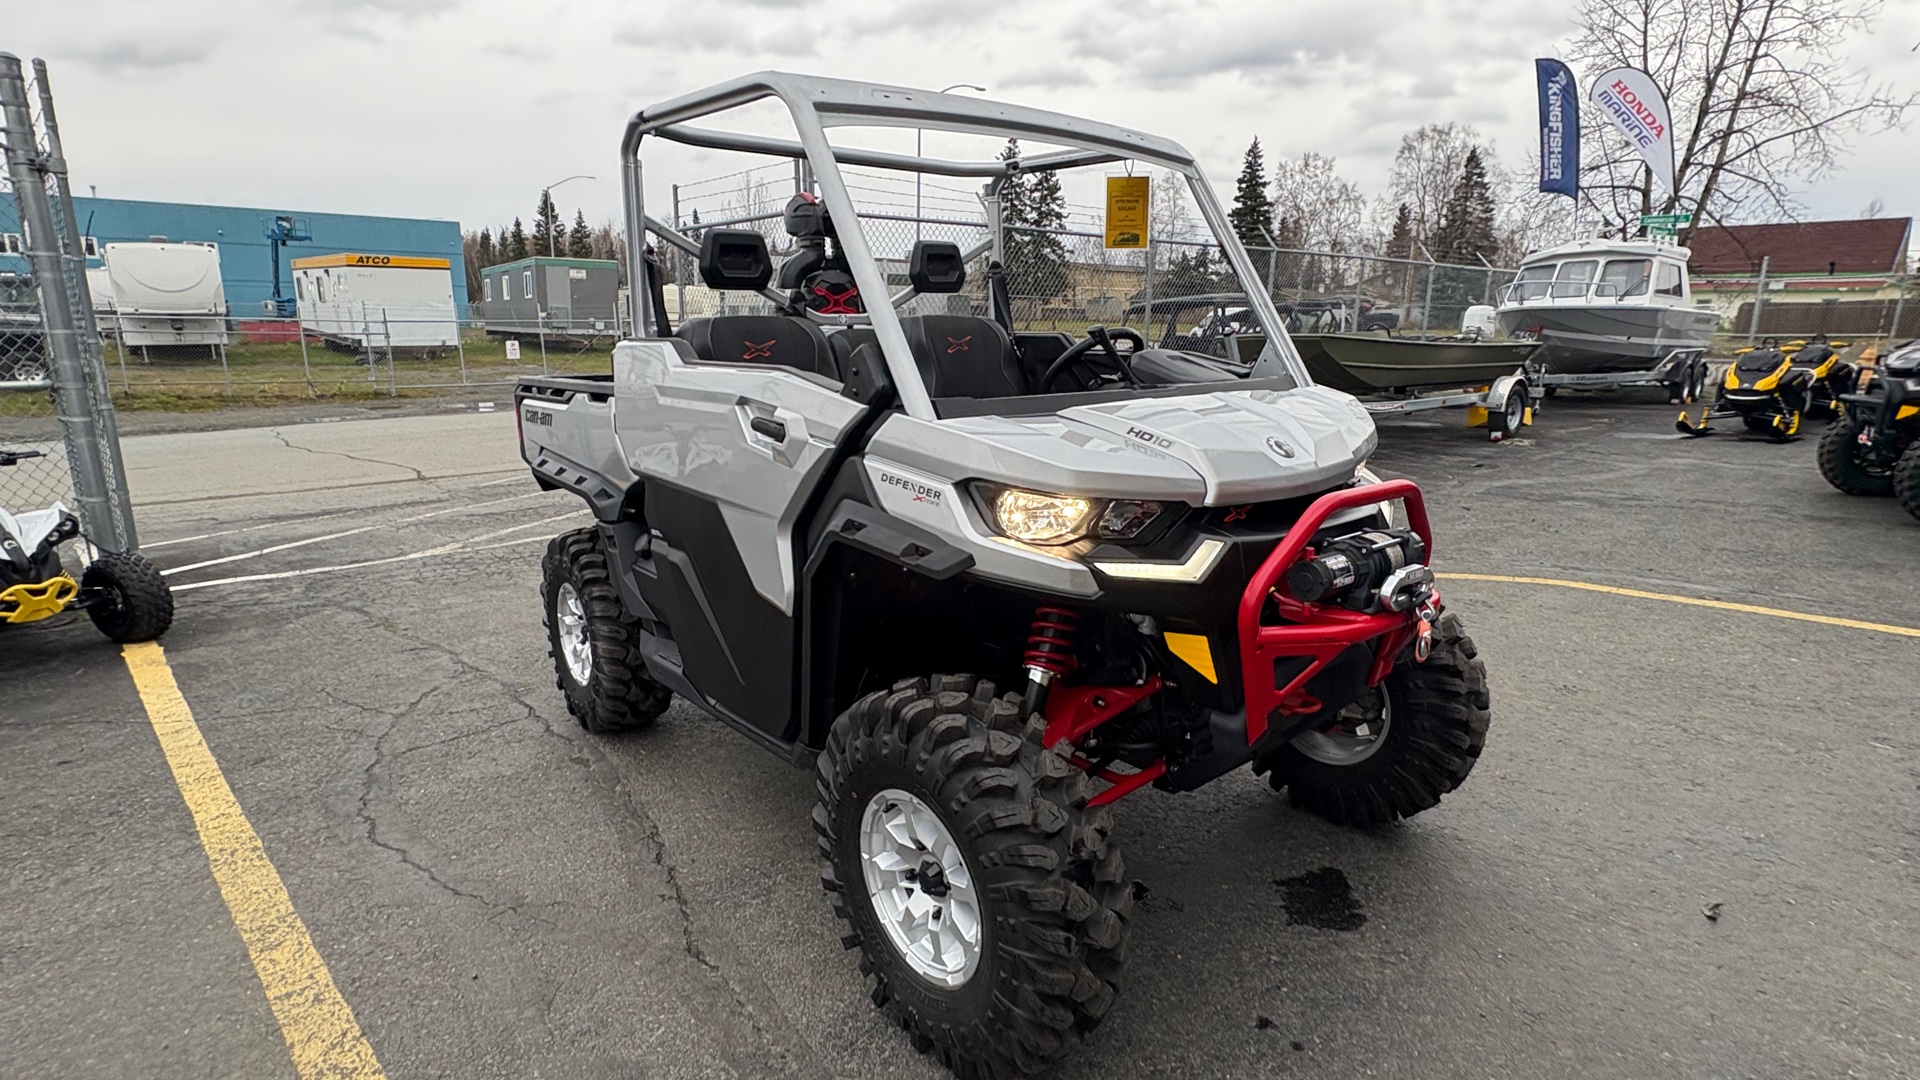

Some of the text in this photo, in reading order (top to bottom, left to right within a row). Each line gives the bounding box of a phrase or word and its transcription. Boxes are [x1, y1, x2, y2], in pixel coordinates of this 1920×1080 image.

[1597, 89, 1653, 149] MARINE
[1610, 79, 1666, 139] HONDA
[1548, 82, 1563, 180] KINGFISHER
[356, 256, 391, 265] ATCO
[1126, 426, 1174, 449] HD10
[881, 473, 942, 500] DEFENDER
